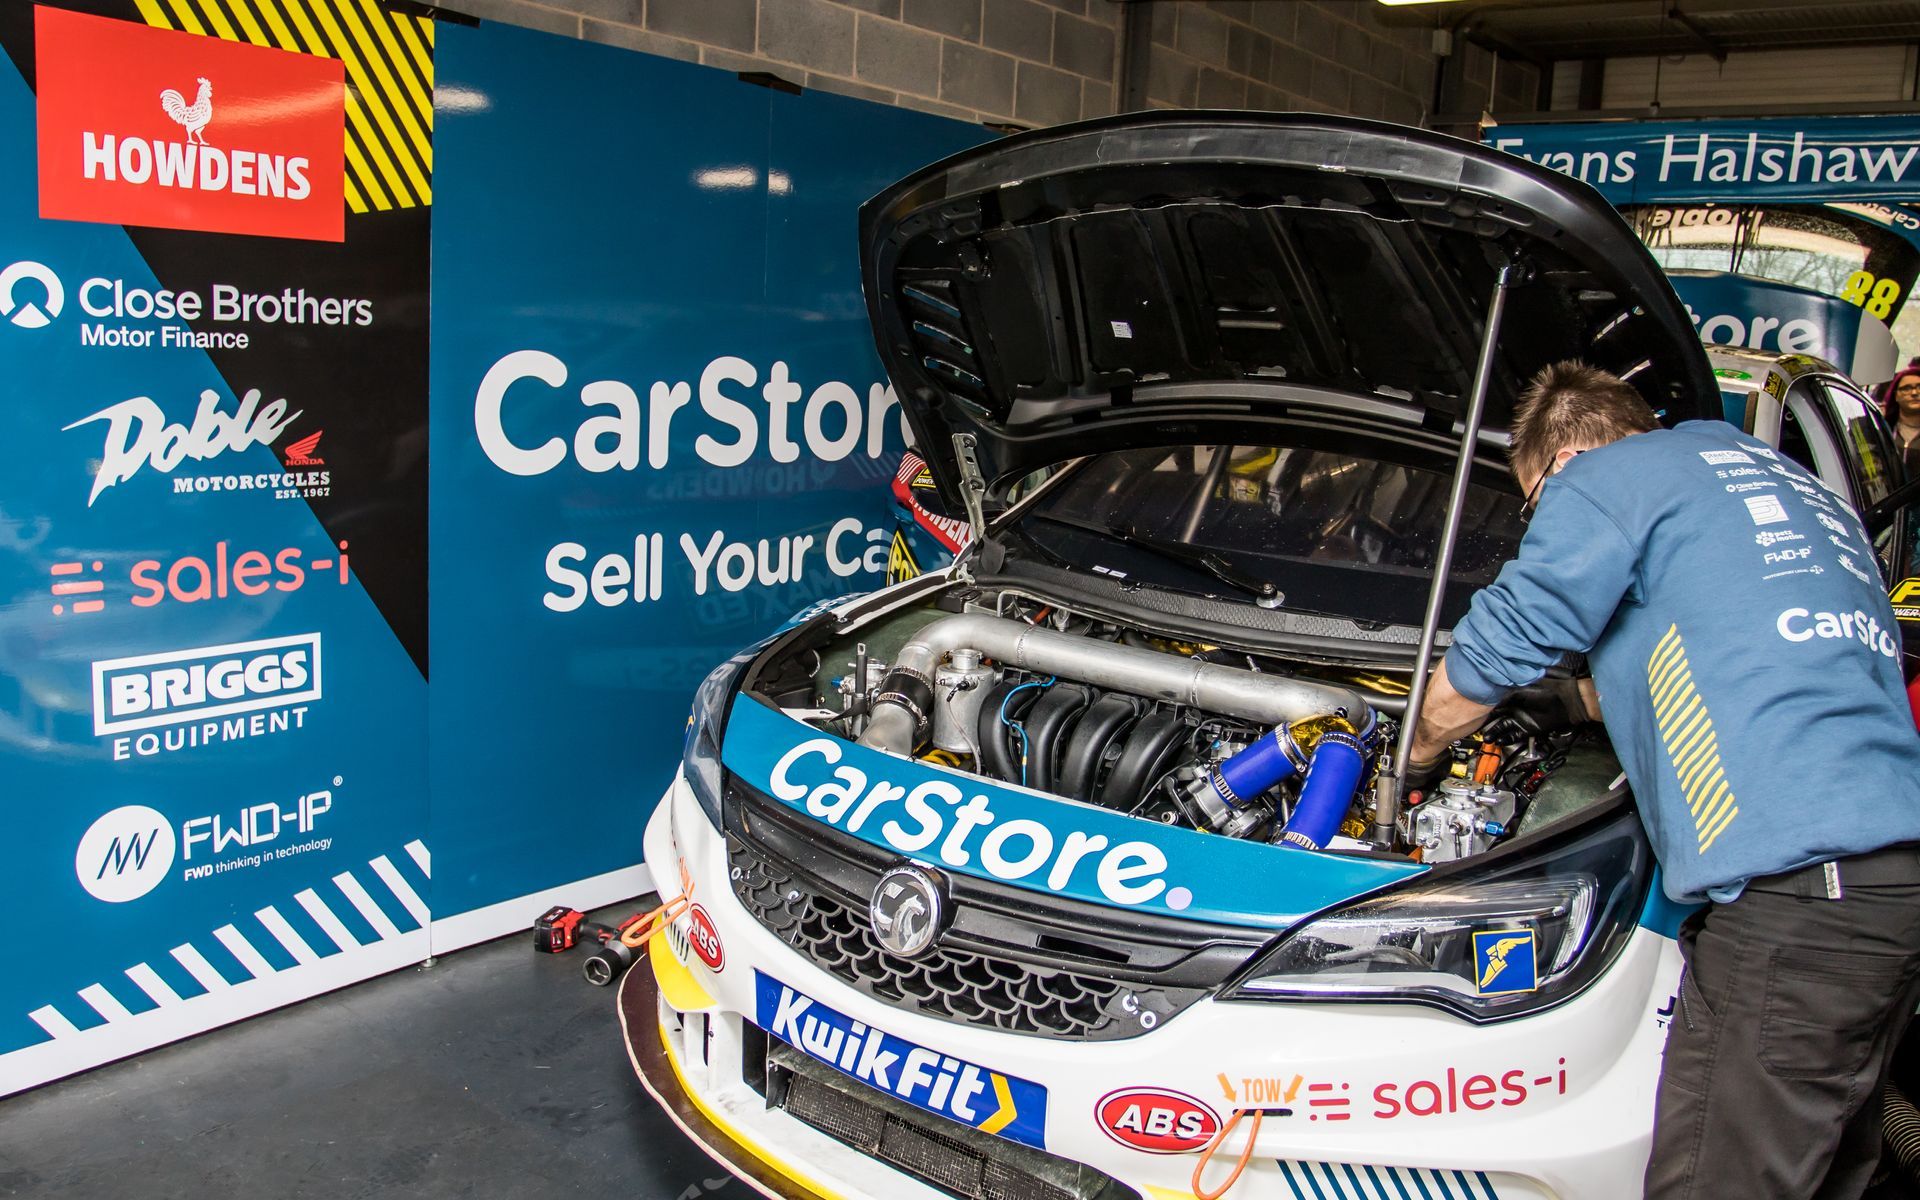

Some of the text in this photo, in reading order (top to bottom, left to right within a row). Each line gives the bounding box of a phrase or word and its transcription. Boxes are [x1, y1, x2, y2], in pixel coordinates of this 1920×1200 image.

[82, 131, 311, 201] HOWDENS
[1496, 131, 1919, 184] ans Halshaw
[79, 276, 374, 327] Close Brothers
[1840, 270, 1900, 320] 88
[80, 324, 250, 350] Motor Finance
[475, 349, 915, 476] CarStor
[61, 389, 303, 508] Doble
[285, 457, 326, 466] HONDA
[173, 470, 331, 494] MOTORCYCLES
[275, 487, 331, 500] EST. 1967
[130, 540, 349, 607] sales-i
[543, 517, 892, 613] Sell Your Ca
[1763, 548, 1811, 565] FWD-IP
[1776, 607, 1903, 671] CarSto
[111, 650, 308, 716] BRIGGS
[113, 706, 308, 761] EQUIPMENT
[183, 790, 332, 861] FWD-IP
[184, 836, 333, 882] FWD thinking in technology
[691, 918, 718, 960] ABS
[1242, 1078, 1282, 1103] TOW
[1373, 1057, 1567, 1119] sales-i
[1112, 1102, 1205, 1142] ABS
